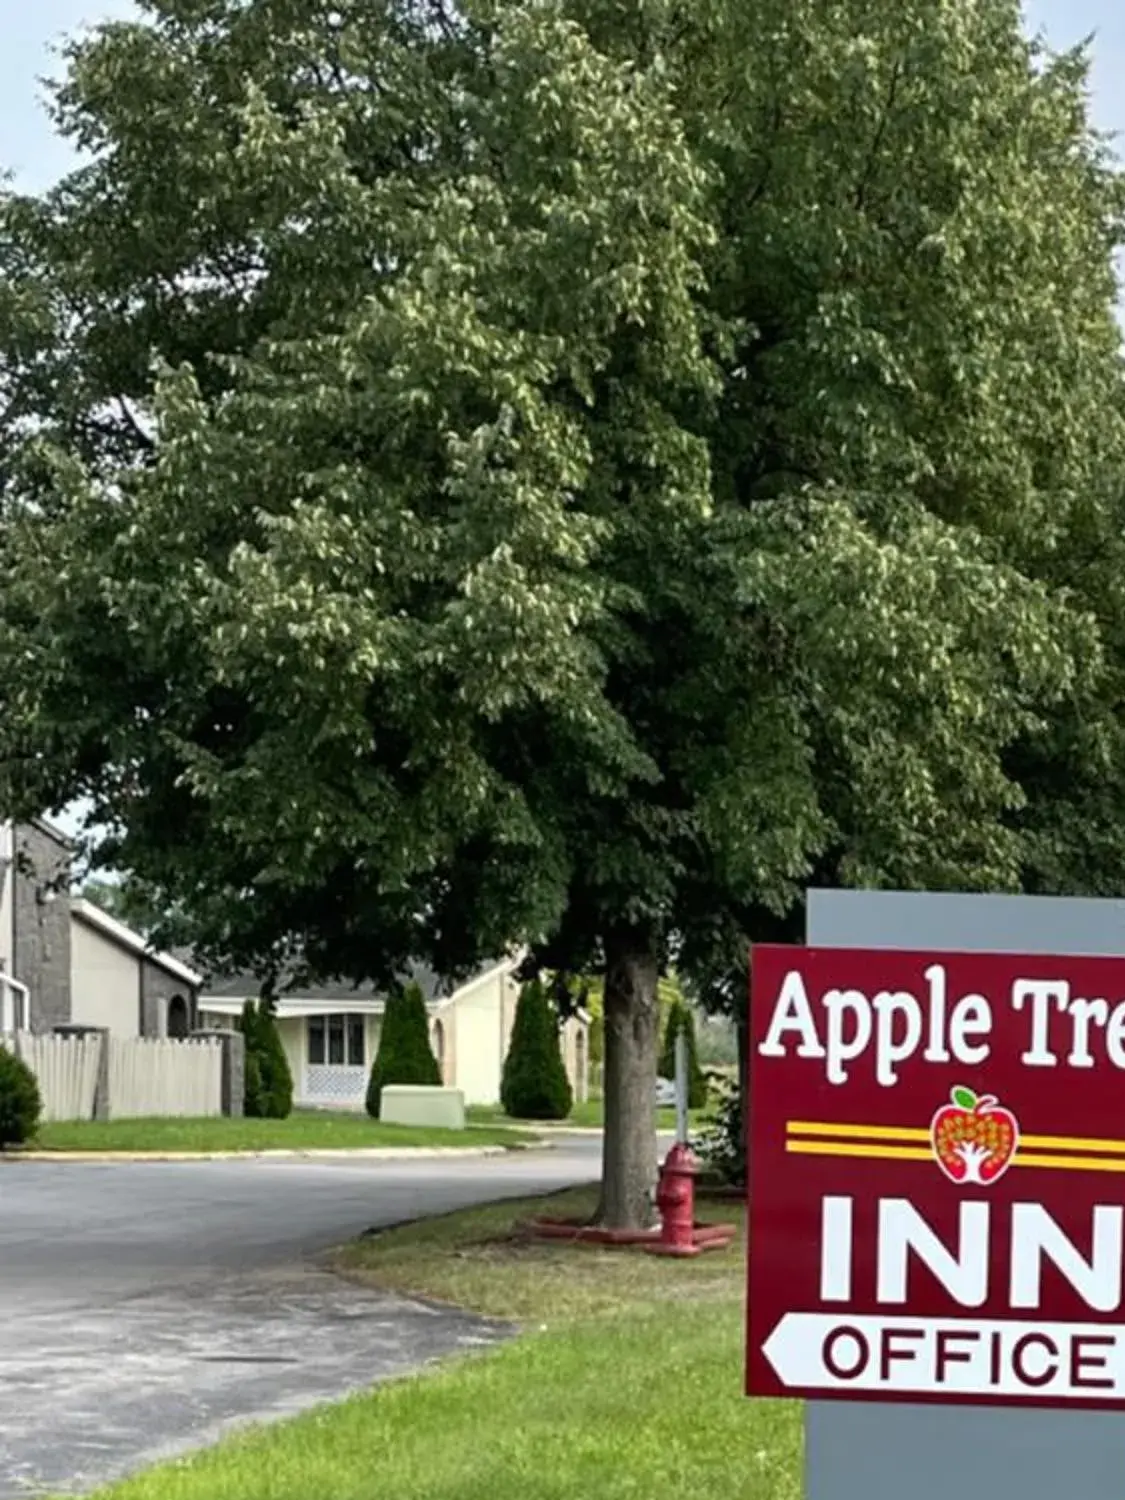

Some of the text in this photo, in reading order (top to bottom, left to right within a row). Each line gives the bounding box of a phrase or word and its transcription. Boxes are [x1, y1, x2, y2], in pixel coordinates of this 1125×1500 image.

[758, 964, 993, 1087] Apple
[820, 1195, 1124, 1312] INN
[821, 1325, 1117, 1389] OFFICE
